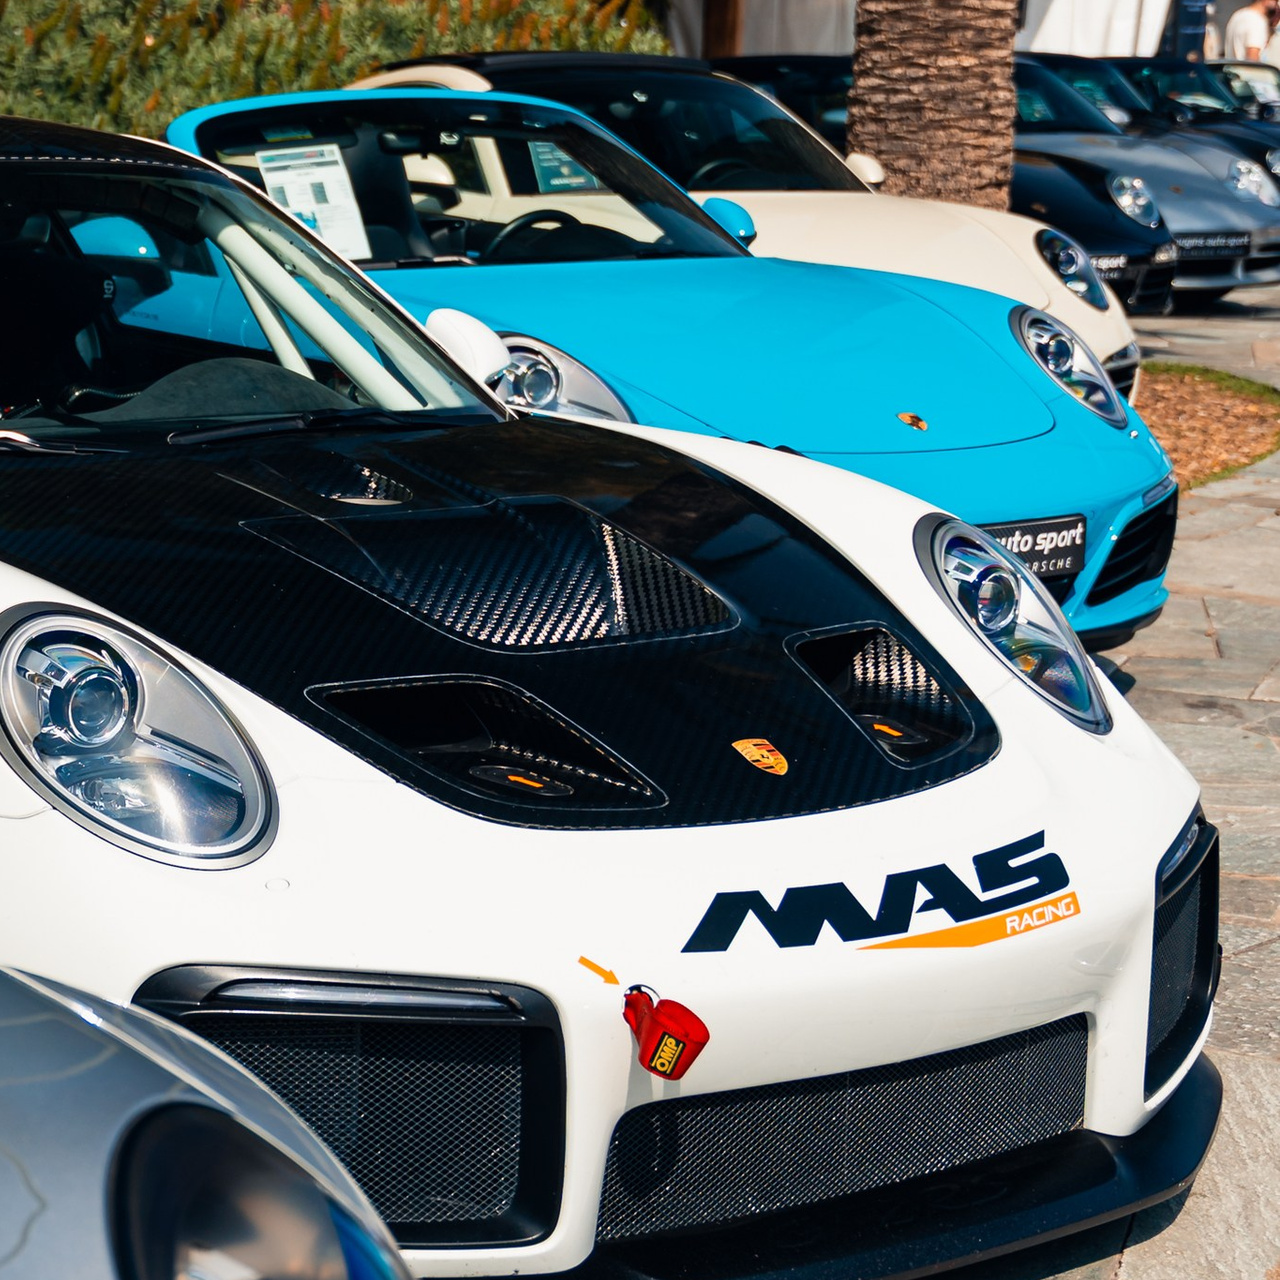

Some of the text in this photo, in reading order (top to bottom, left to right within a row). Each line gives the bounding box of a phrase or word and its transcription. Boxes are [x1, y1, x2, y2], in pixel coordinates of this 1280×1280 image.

[1097, 254, 1127, 271] sport
[1035, 522, 1084, 554] sport
[1027, 557, 1072, 573] RSCHE
[681, 830, 1069, 953] MAS
[1006, 897, 1074, 934] RACING
[656, 1038, 677, 1072] OMP
